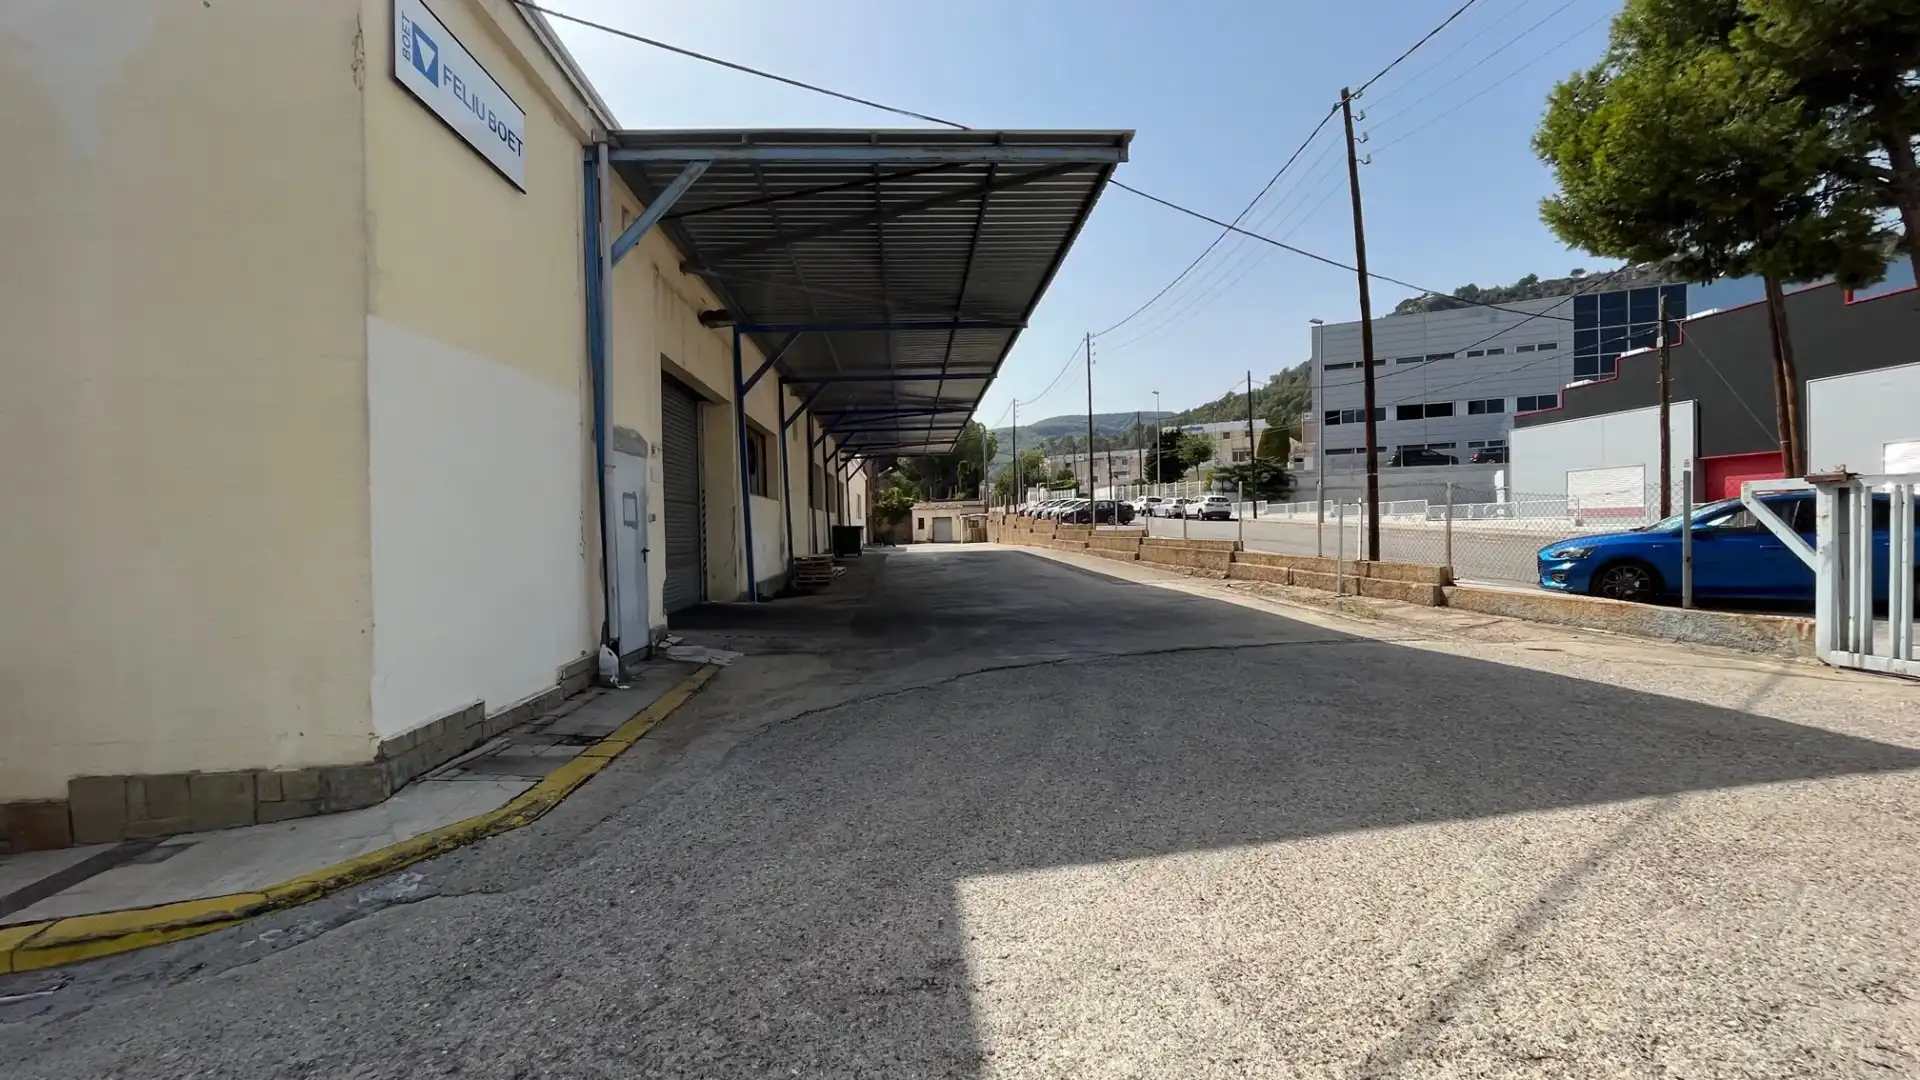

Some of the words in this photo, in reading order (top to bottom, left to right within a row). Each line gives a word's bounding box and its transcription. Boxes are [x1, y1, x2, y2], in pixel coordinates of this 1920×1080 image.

[401, 10, 411, 61] BOET
[443, 64, 485, 121] FELIU
[488, 109, 523, 157] BOET
